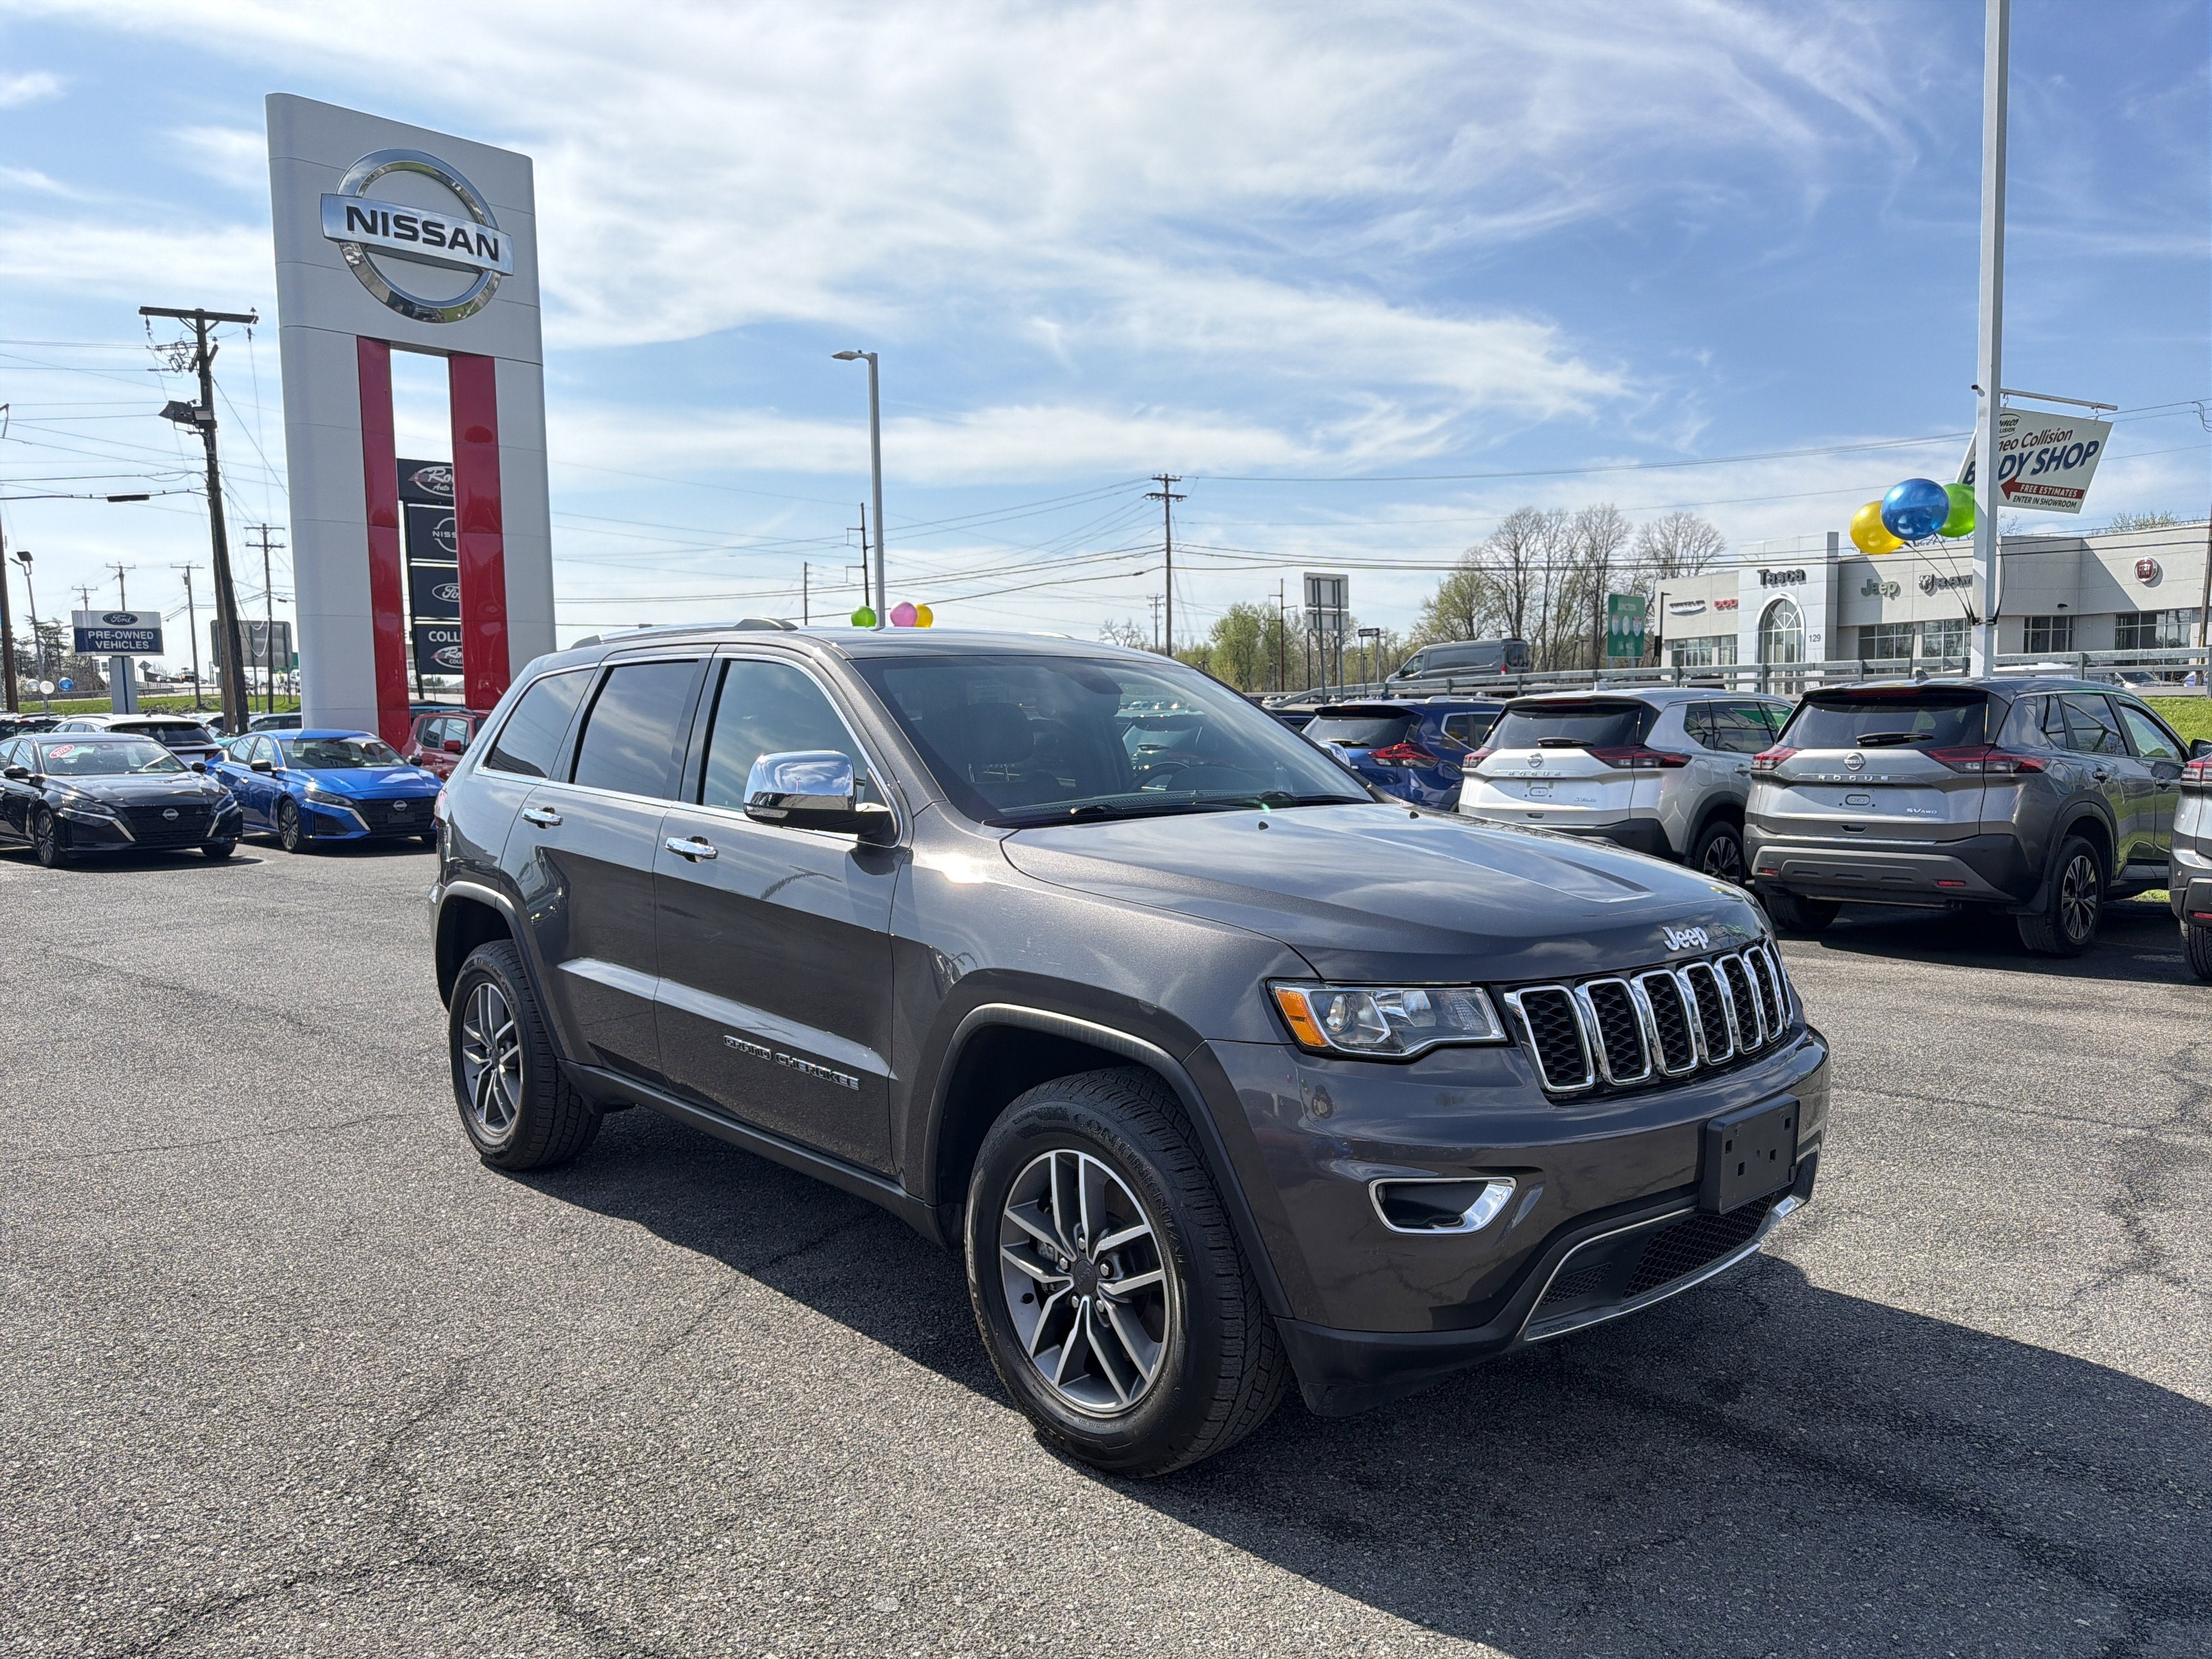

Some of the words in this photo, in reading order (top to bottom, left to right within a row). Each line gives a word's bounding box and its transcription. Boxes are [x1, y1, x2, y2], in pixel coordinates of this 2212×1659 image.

[346, 206, 499, 262] NISSAN
[2000, 419, 2019, 427] meo
[2021, 427, 2073, 448] Collision
[1962, 451, 2034, 484] BDY
[2030, 441, 2099, 476] SHOP
[427, 468, 453, 483] Ro
[432, 483, 449, 491] Auto
[2020, 484, 2038, 494] FREE
[2039, 486, 2078, 498] ESTIMATES
[2013, 495, 2031, 504] ENTER
[2039, 498, 2077, 508] SHOWROOM
[1757, 568, 1806, 585] Tasca
[442, 585, 459, 599] Fo
[1861, 579, 1898, 597] Jeep
[1714, 599, 1737, 608] DOD
[111, 614, 131, 623] Ford
[88, 631, 154, 639] PRE-OWNED
[428, 631, 461, 642] COLL
[1809, 634, 1821, 643] 129
[95, 641, 149, 650] VEHICLES
[1663, 927, 1708, 950] Jeep
[724, 1035, 772, 1060] GRAND
[775, 1053, 860, 1091] CHEROKEE
